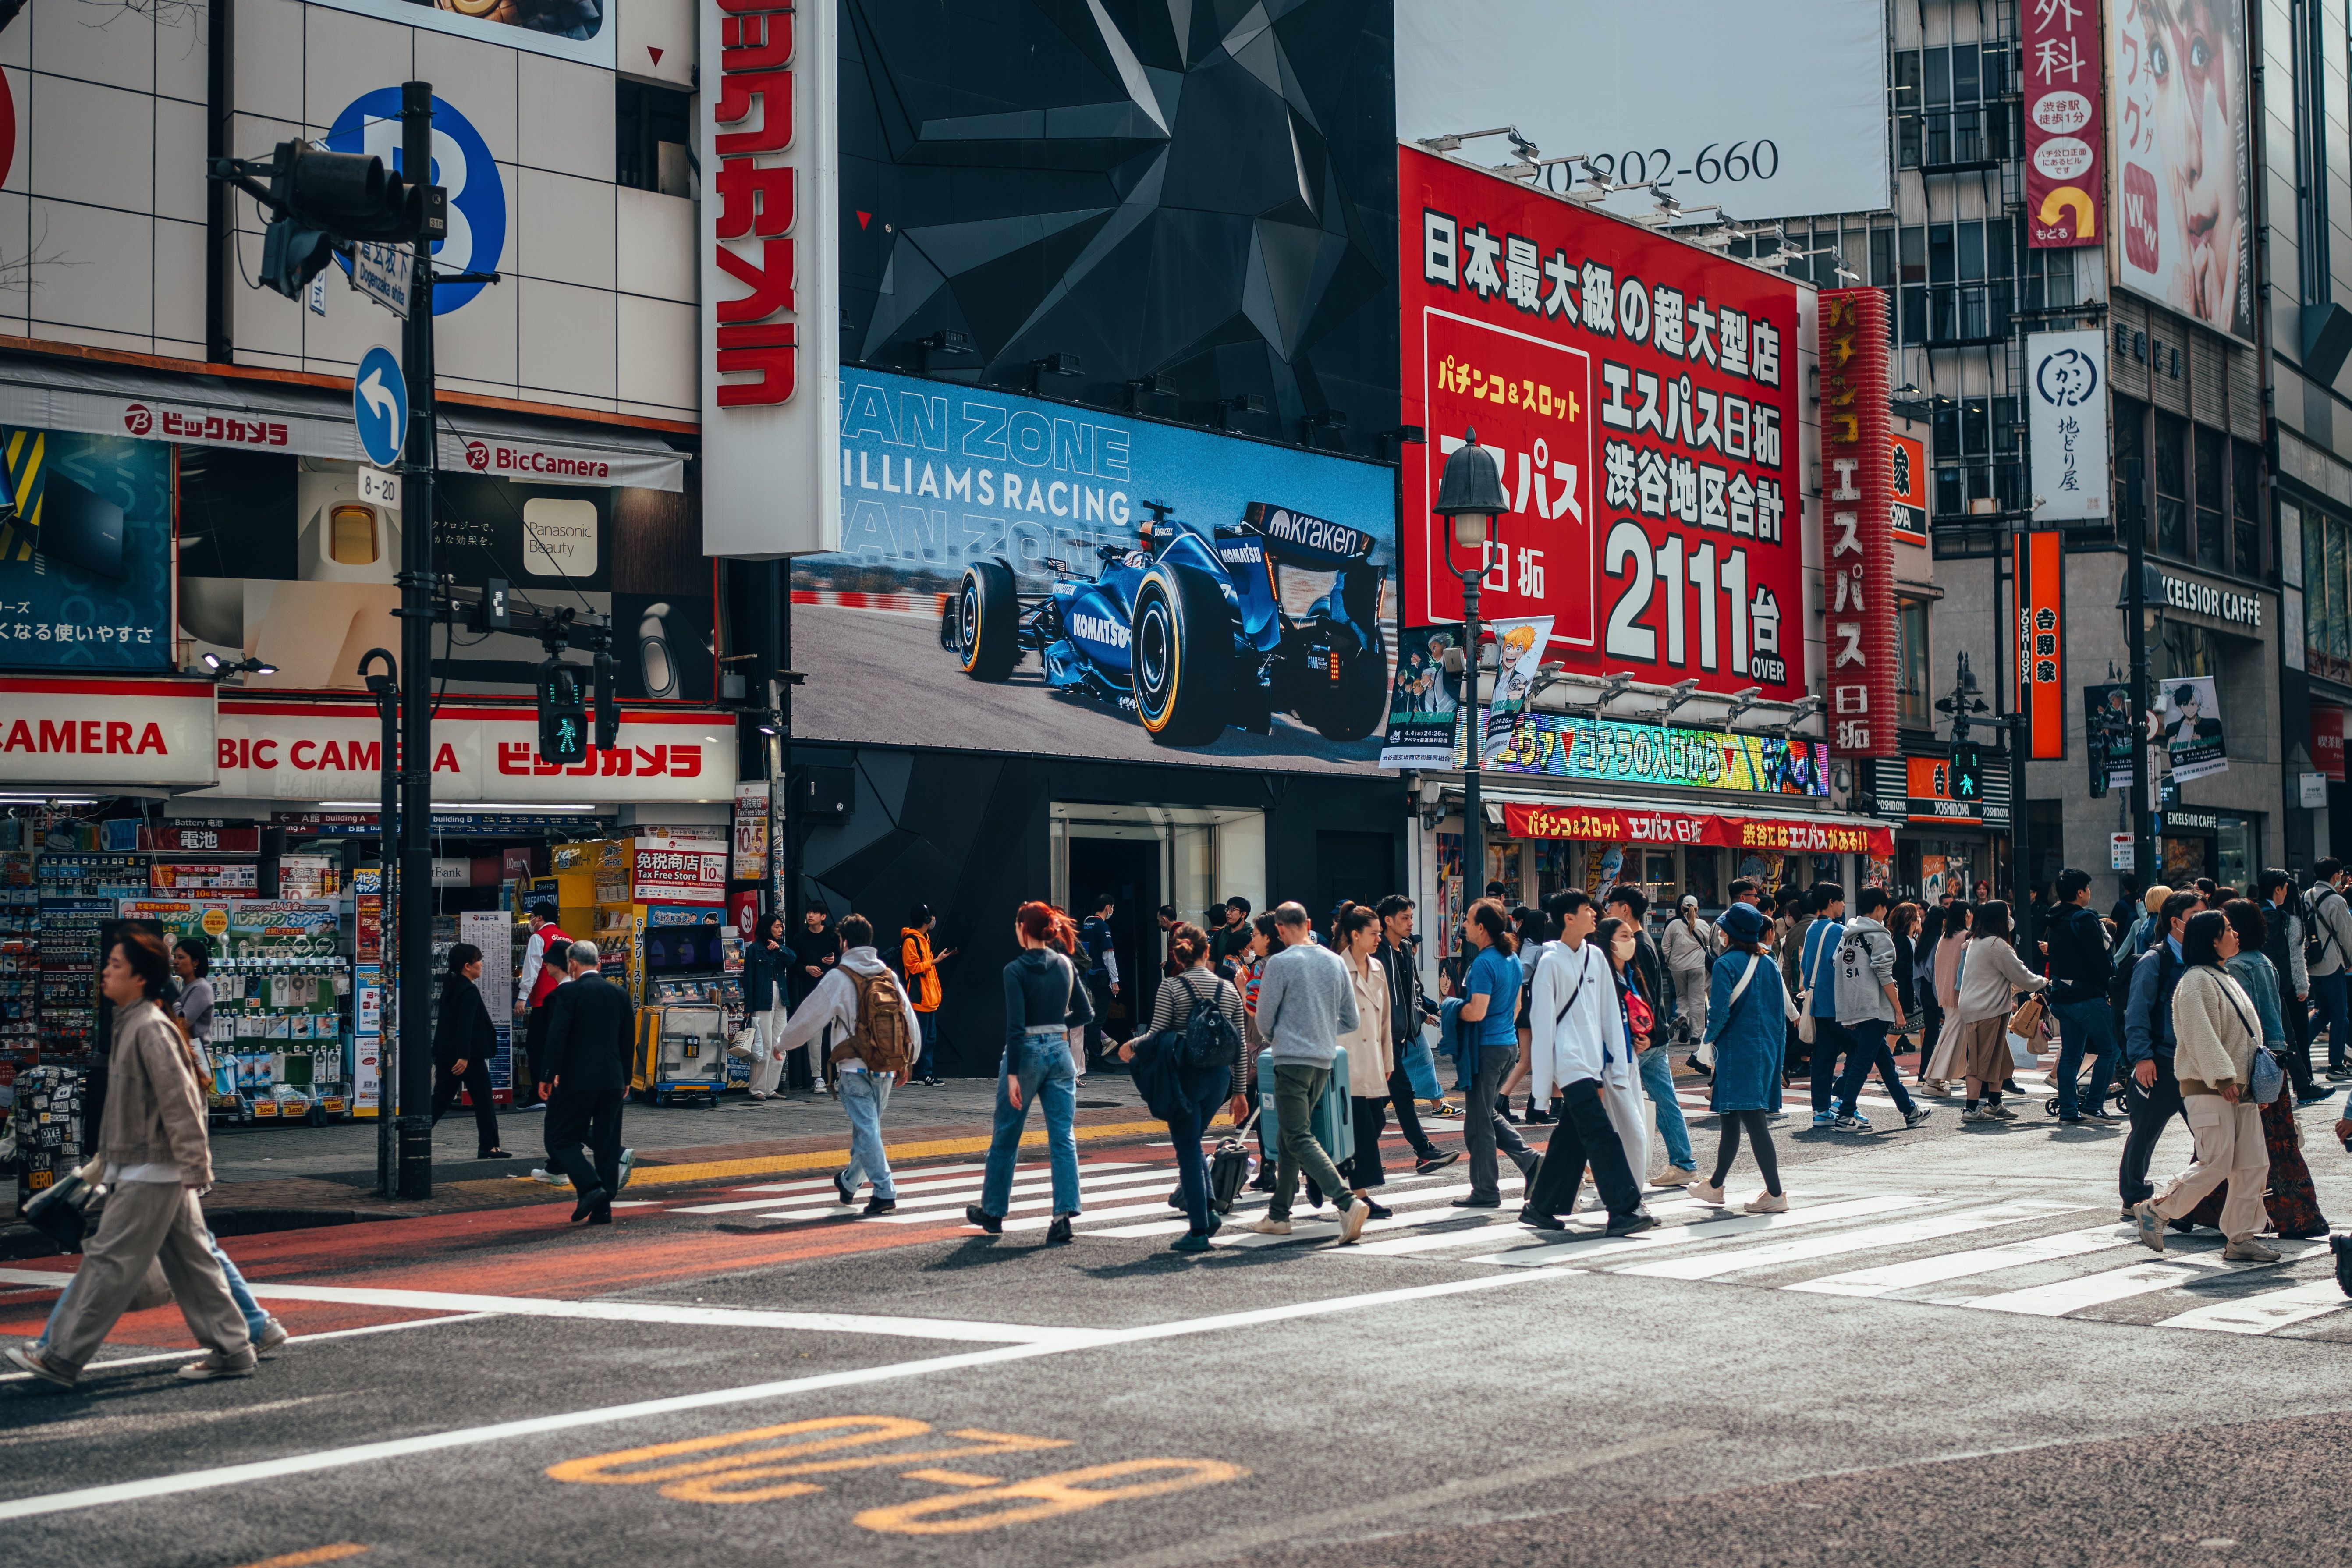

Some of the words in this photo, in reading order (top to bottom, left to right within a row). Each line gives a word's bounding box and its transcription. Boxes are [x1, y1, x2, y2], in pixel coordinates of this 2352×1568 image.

[2034, 0, 2086, 85] 外科
[2043, 99, 2079, 112] 渋谷駅
[2039, 112, 2085, 125] 徒歩1分
[2037, 148, 2086, 158] ハチ公口正面
[2042, 158, 2082, 167] にあるビル
[364, 114, 472, 277] B
[2036, 227, 2068, 240] もどる
[360, 262, 390, 297] Dogenzaka
[392, 284, 404, 306] shita
[1424, 209, 1782, 390] 日本最大級の超大型店
[2054, 348, 2082, 408] つかだ
[1438, 355, 1580, 422] パチンコ&スロット
[163, 412, 288, 446] ビックカメラ
[839, 381, 947, 453] AN
[963, 401, 1131, 482] ZONE
[497, 448, 609, 478] BicCamera
[2058, 416, 2080, 492] 地どり屋
[365, 475, 395, 501] 8-20
[1604, 440, 1785, 544] 渋谷地区合計
[1004, 472, 1130, 527] RACING
[529, 521, 592, 539] Panasonic
[839, 500, 947, 566] AN
[1154, 527, 1173, 537] DURACELL
[1289, 514, 1357, 555] kraken
[529, 539, 574, 557] Beauty
[1220, 543, 1262, 563] KOMATSU
[1605, 519, 1749, 677] 2111
[1751, 584, 1781, 654] 台
[2223, 592, 2262, 627] CAFFÉ
[1073, 613, 1132, 649] KOMATSU
[2021, 607, 2030, 685] YOSHINOYA
[2035, 607, 2057, 683] 吉野家
[1752, 656, 1785, 685] OVER
[1389, 712, 1412, 724] WIND
[1412, 711, 1456, 724] BREAKER
[218, 738, 279, 769] BIC
[742, 798, 762, 808] 免税商店
[1877, 799, 1907, 812] YOSHINOYA
[1934, 801, 1970, 817] YOSHINOYA
[1983, 806, 2009, 818] YOSHINOYA
[302, 814, 319, 823] A館
[1528, 814, 1620, 839] パチンコ&スロット
[1628, 812, 1674, 842] エスパス
[2168, 812, 2198, 827] EXCELSIOR
[2199, 813, 2217, 829] CAFFÉ
[180, 831, 218, 849] 電池
[1742, 823, 1868, 853] 渋谷にはエスパスがある!!
[507, 858, 514, 870] UQ
[637, 851, 699, 871] 免税商店
[289, 868, 319, 876] 免税商店
[638, 870, 653, 879] Tax
[654, 870, 673, 880] Free
[674, 871, 697, 881] Store
[703, 867, 724, 880] 10%
[547, 894, 557, 906] SIM
[234, 913, 286, 926] ハンディファン
[287, 913, 337, 925] ネッククーラー
[551, 934, 573, 944] docomo
[42, 1128, 60, 1138] OYE
[43, 1136, 61, 1146] RUNS
